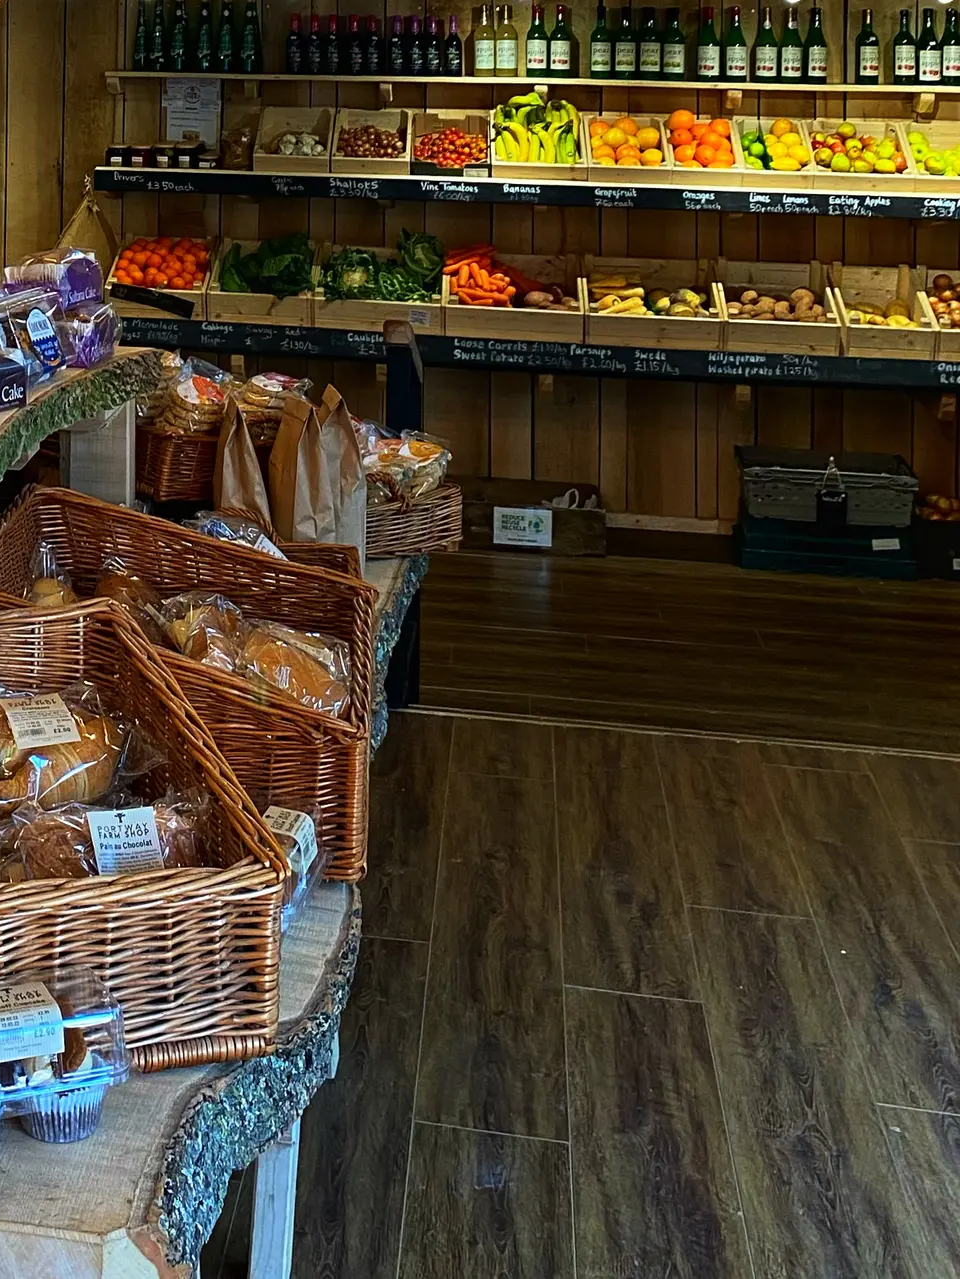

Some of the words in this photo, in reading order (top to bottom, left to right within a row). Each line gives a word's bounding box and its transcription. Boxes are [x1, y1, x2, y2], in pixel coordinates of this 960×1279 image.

[174, 183, 195, 192] each
[328, 177, 380, 190] Shallots
[420, 181, 440, 192] Vine
[439, 181, 479, 194] Tomatoes
[502, 183, 541, 194] Bananas
[594, 188, 638, 199] Grapefruit
[682, 190, 716, 203] Oranges
[749, 191, 772, 203] Limes
[782, 193, 809, 204] Lemons
[828, 195, 861, 210] Eating
[863, 196, 891, 207] Apples
[923, 198, 957, 212] Cooking
[201, 321, 234, 334] Cabbage
[453, 338, 485, 349] Loose
[488, 340, 528, 352] Carrots
[569, 343, 613, 359] Parsnips
[453, 349, 487, 361] Sweet
[634, 349, 667, 361] Swede
[708, 364, 743, 375] Washed
[1, 383, 24, 402] Cake
[97, 822, 148, 833] PORTWAY
[98, 831, 121, 839] FARM
[124, 828, 150, 838] SHOP
[122, 839, 153, 850] Chocolat
